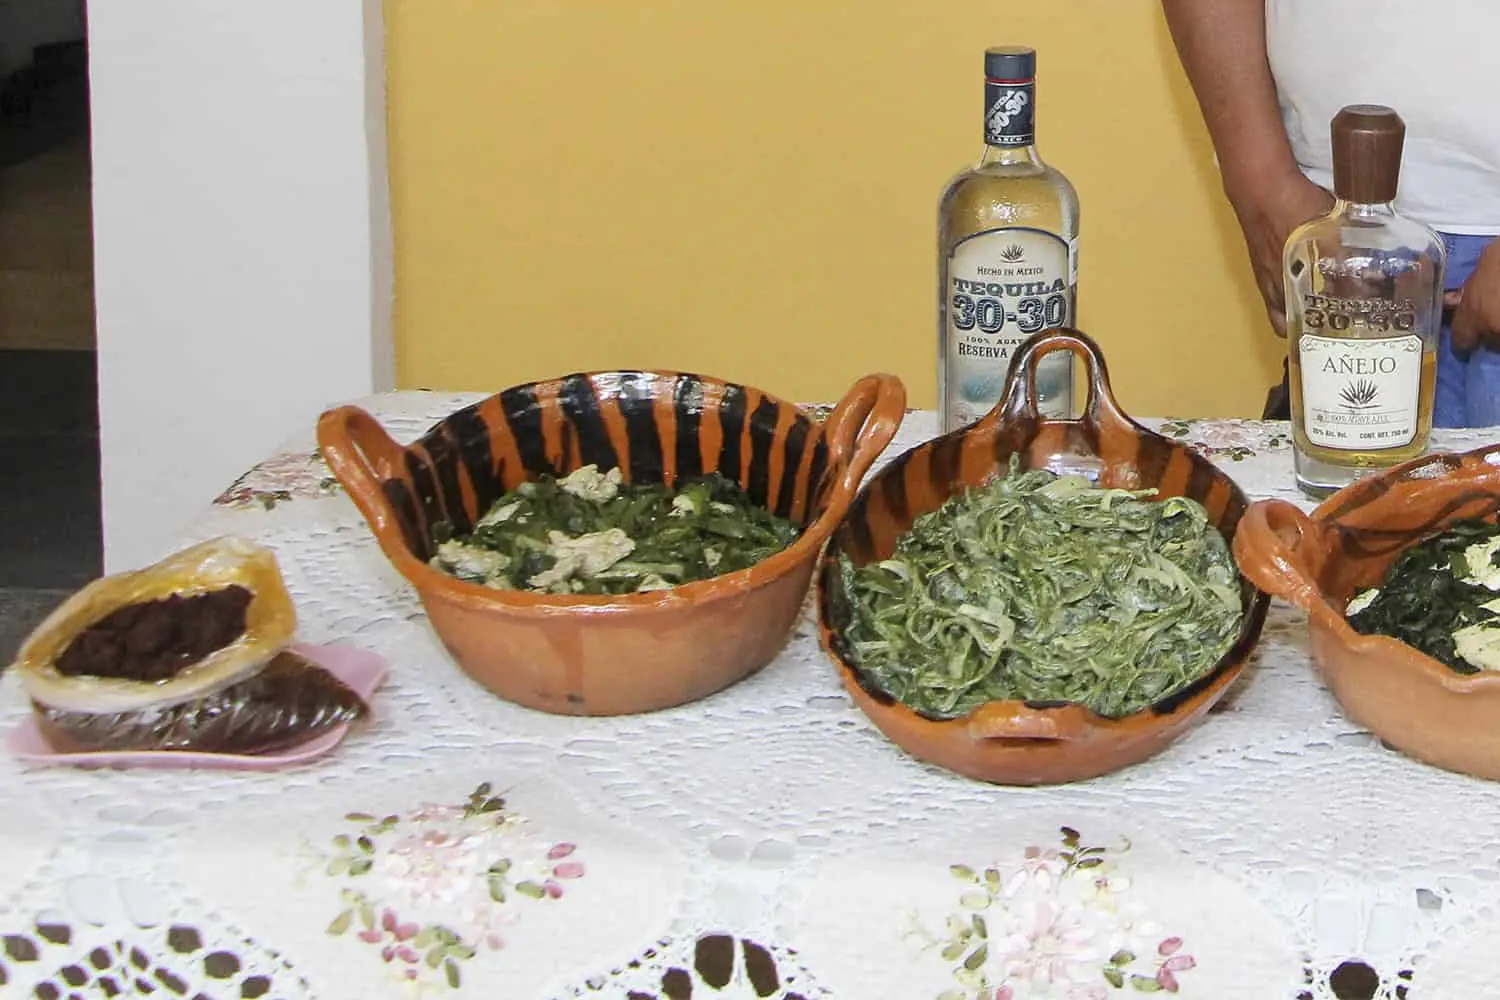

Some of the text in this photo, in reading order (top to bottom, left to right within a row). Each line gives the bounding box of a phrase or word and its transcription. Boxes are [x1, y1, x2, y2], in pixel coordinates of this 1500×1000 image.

[977, 266, 1001, 275] HECHO
[953, 277, 1066, 298] TEQUILA
[1303, 294, 1416, 312] TEQUILA
[952, 294, 1066, 334] 30-30
[1303, 308, 1416, 332] 30-30
[966, 336, 991, 344] 100%
[959, 342, 1008, 358] RESERVA
[1322, 353, 1396, 374] AÑEJO
